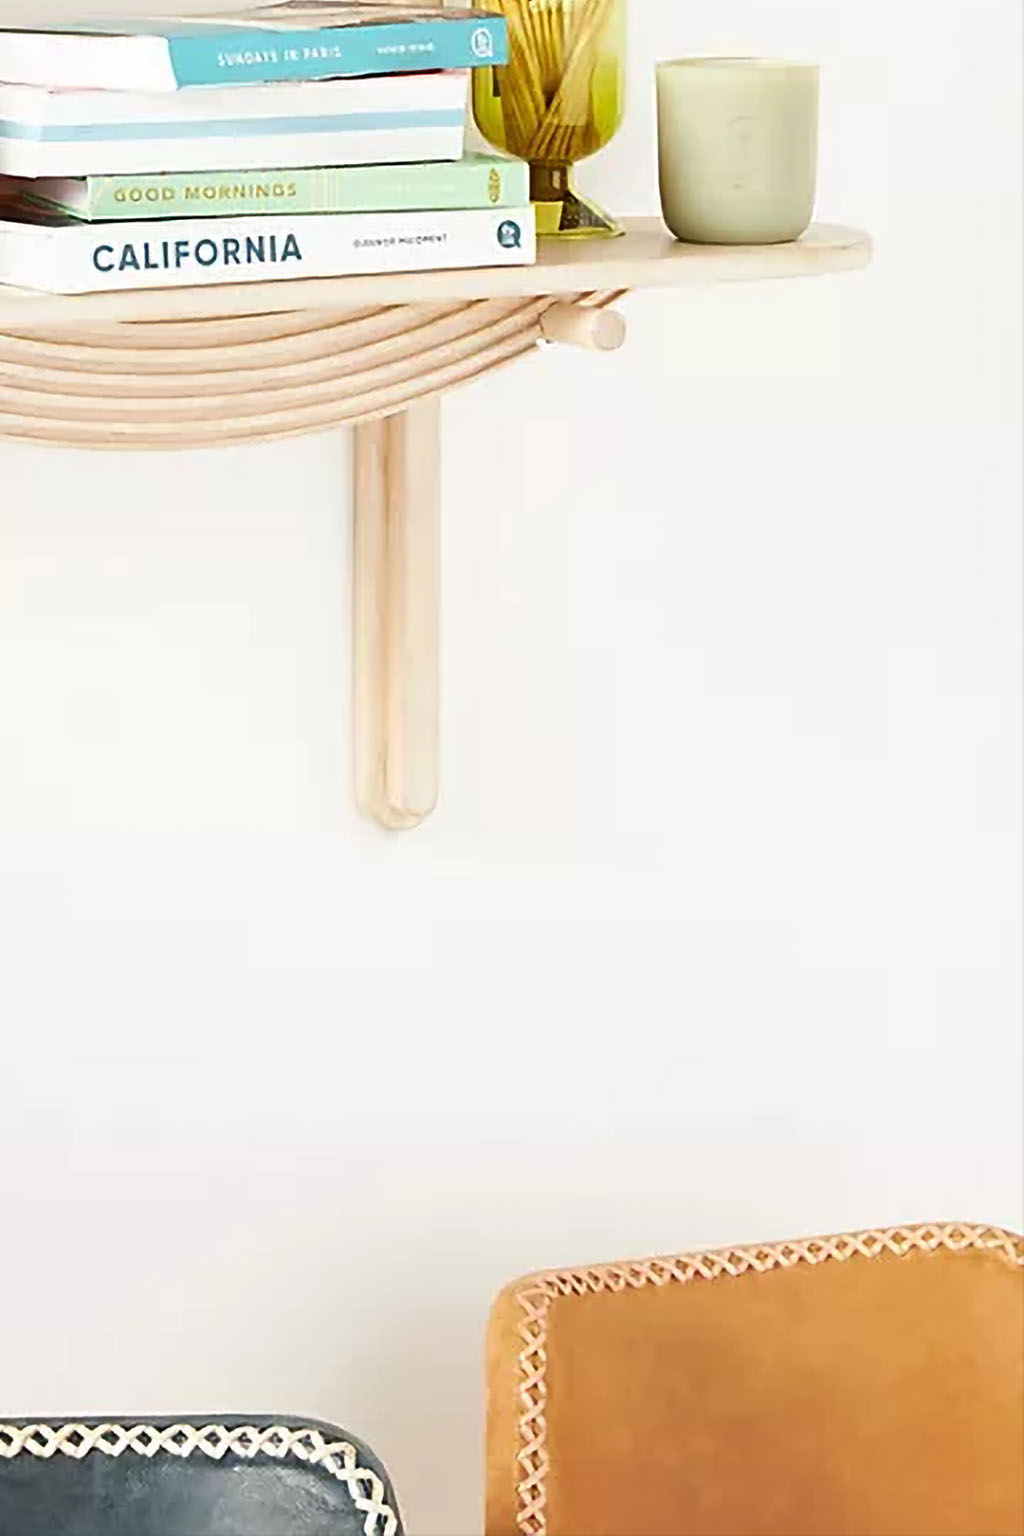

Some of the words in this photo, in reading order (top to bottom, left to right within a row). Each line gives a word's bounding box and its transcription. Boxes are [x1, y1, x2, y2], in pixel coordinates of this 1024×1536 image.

[217, 49, 278, 66] SUNDAYS
[303, 45, 343, 60] PARIS
[113, 187, 175, 202] GOOD
[184, 182, 297, 200] MORNINGS
[92, 233, 303, 272] CALIFORNIA
